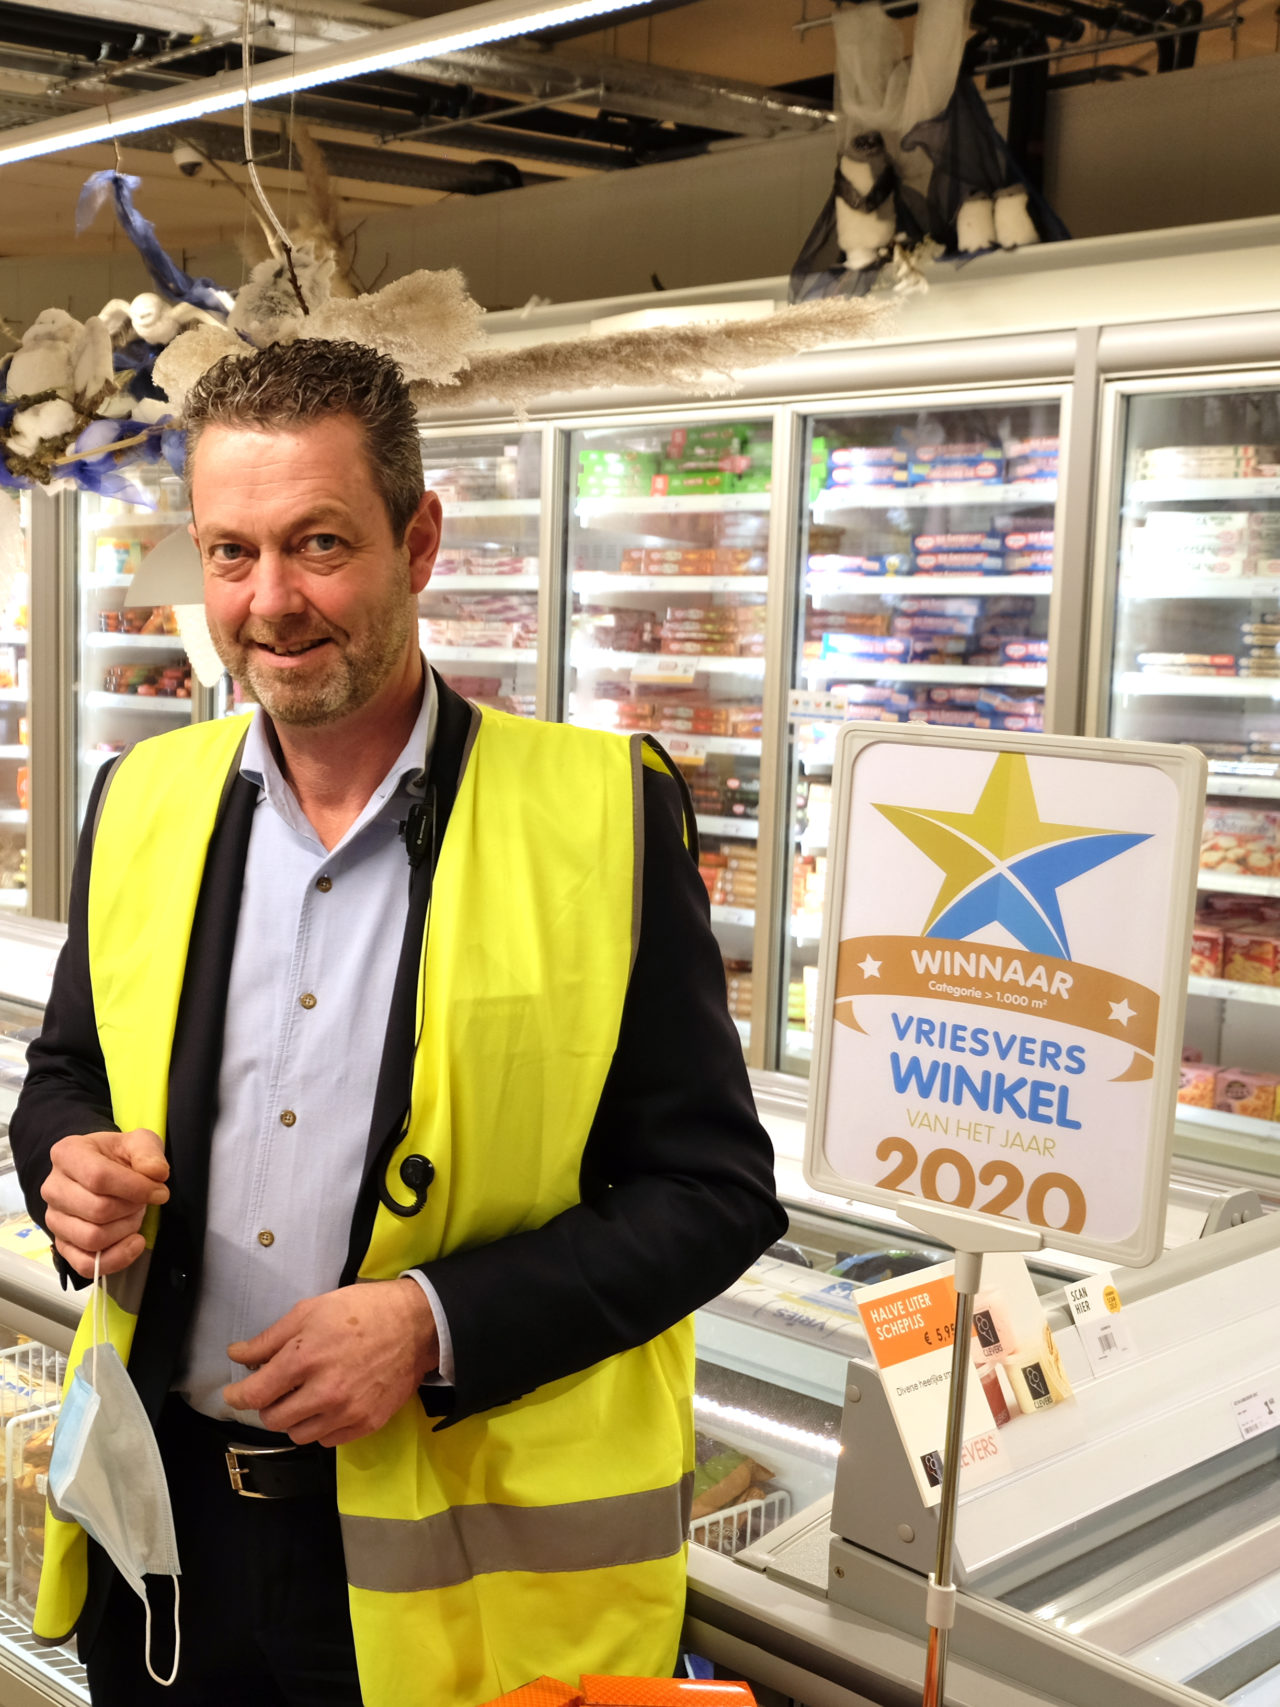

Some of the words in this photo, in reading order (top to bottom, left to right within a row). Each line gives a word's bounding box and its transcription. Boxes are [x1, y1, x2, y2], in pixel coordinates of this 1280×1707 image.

[911, 949, 1074, 1000] WINNAAR
[928, 980, 982, 999] Categorie
[996, 991, 1029, 1007] 1.000
[891, 1013, 1086, 1075] VRIESVERS
[890, 1051, 1082, 1131] WINKEL
[906, 1108, 949, 1135] VAN
[956, 1119, 995, 1145] HET
[1000, 1129, 1056, 1159] JAAR
[875, 1136, 1087, 1235] 2020
[870, 1300, 906, 1323] HALVE
[905, 1292, 932, 1313] LITER
[1070, 1286, 1089, 1302] SCAN
[1074, 1300, 1091, 1315] HIER
[876, 1313, 925, 1341] SCHEPIJS
[983, 1344, 1003, 1357] CLEVERS
[1034, 1395, 1054, 1409] CLEVERS
[960, 1435, 998, 1468] EVERS
